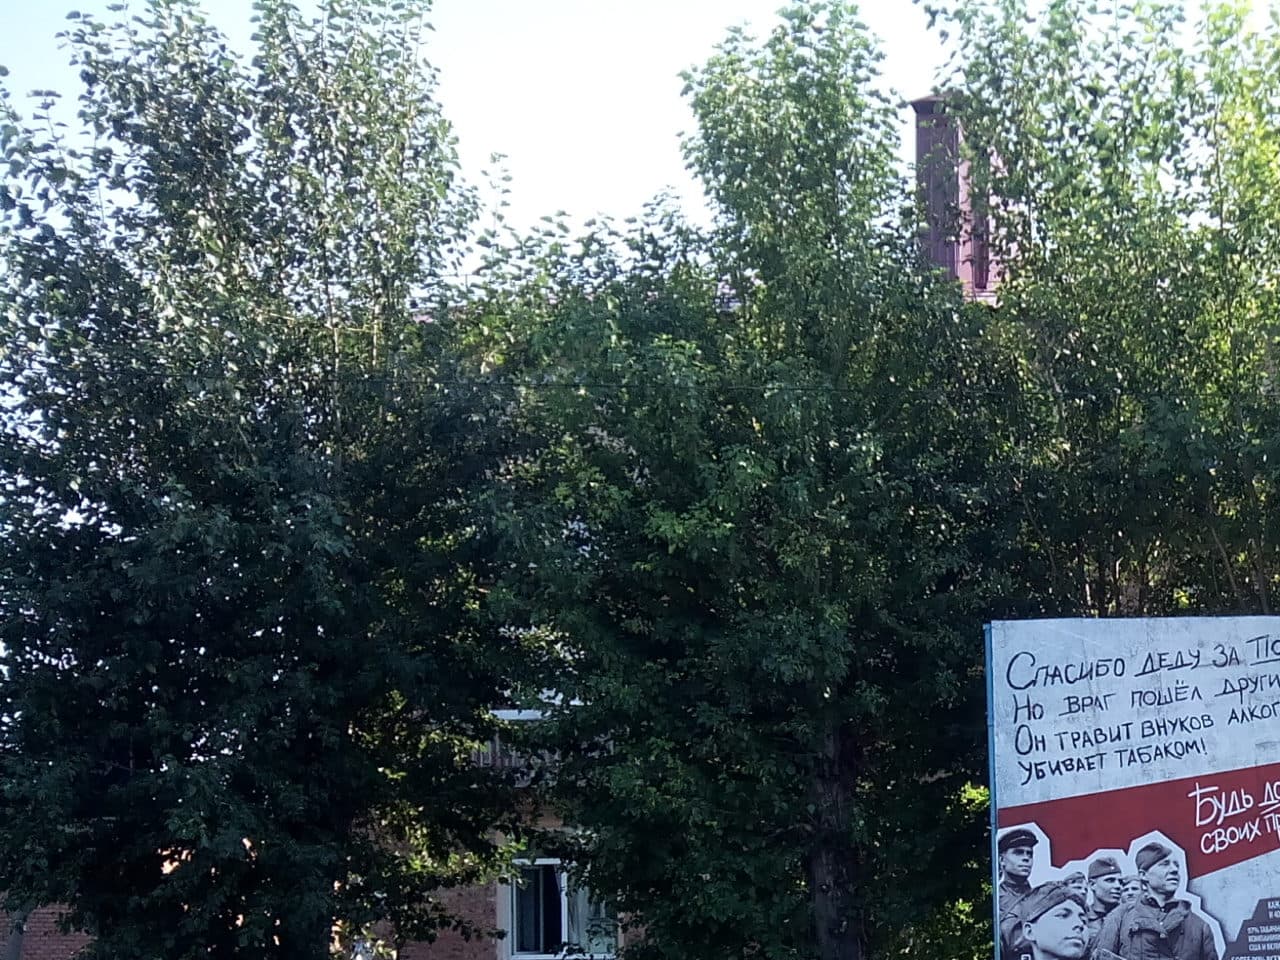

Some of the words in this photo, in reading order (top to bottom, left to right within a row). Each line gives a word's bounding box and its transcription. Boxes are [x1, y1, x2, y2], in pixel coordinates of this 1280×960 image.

[1134, 648, 1201, 677] ДЕДУ
[1212, 644, 1240, 668] ЗА
[1058, 693, 1117, 716] ВРАГ
[1131, 680, 1202, 708] ПОШЁЛ
[1054, 722, 1134, 751] ТРАВИТ
[1141, 713, 1214, 739] ВНУКОВ
[1017, 752, 1107, 786] УБИВАЕТ
[1115, 737, 1207, 769] ТАБАКОМ!
[1201, 817, 1262, 854] СВОИХ
